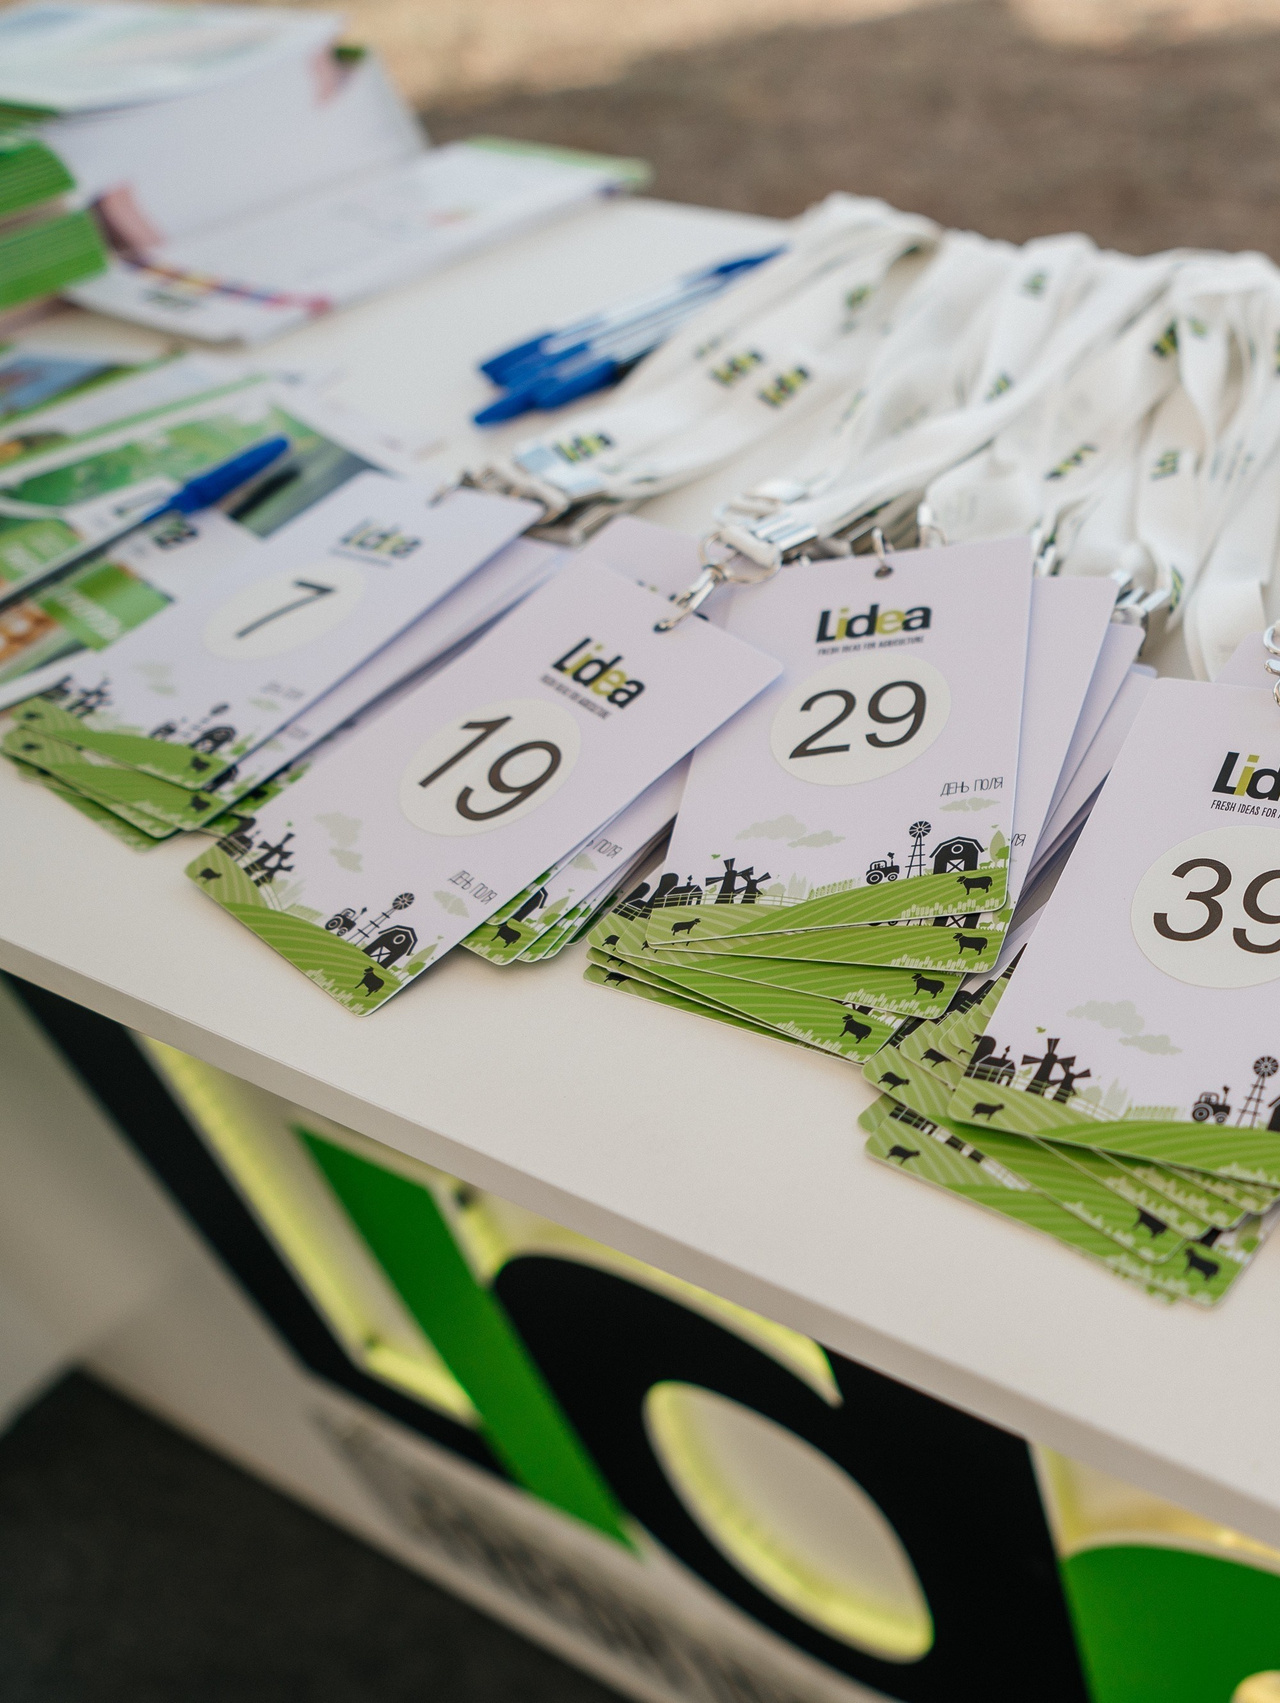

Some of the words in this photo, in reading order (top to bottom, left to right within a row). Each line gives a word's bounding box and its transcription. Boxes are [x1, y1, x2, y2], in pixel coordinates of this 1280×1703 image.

[235, 578, 335, 639] 7
[816, 603, 933, 643] Lidea
[552, 637, 645, 709] Lidea
[788, 680, 928, 759] 29
[418, 713, 563, 822] 19
[1210, 799, 1238, 812] FRESH
[1238, 803, 1261, 816] IDEAS
[1261, 807, 1277, 819] FOR
